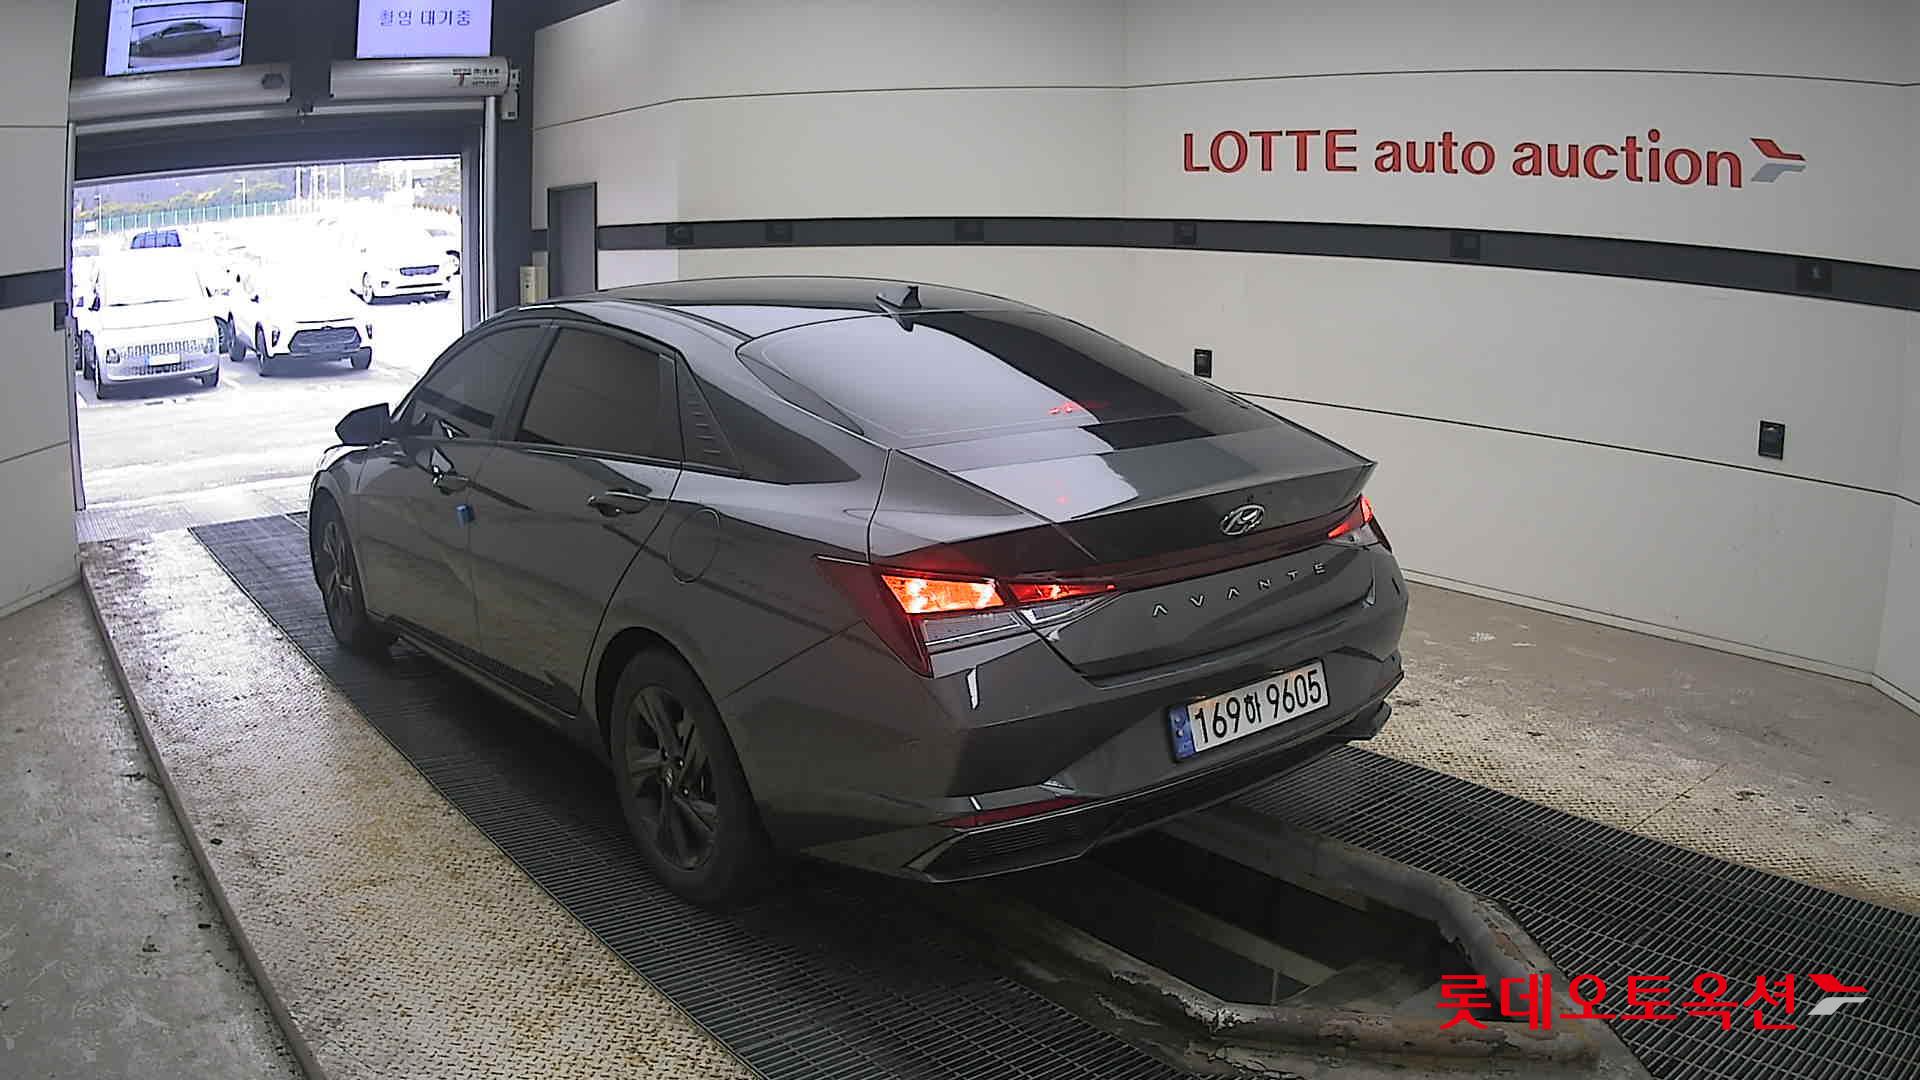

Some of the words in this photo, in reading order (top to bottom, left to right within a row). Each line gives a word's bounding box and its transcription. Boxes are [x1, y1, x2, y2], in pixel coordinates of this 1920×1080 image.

[420, 8, 471, 27] 대기중
[1183, 128, 1358, 175] LOTTE
[1374, 131, 1497, 177] auto
[1511, 127, 1744, 189] auction
[1152, 561, 1327, 617] AVANTE
[1193, 692, 1263, 745] 169하
[1266, 669, 1322, 720] 9605
